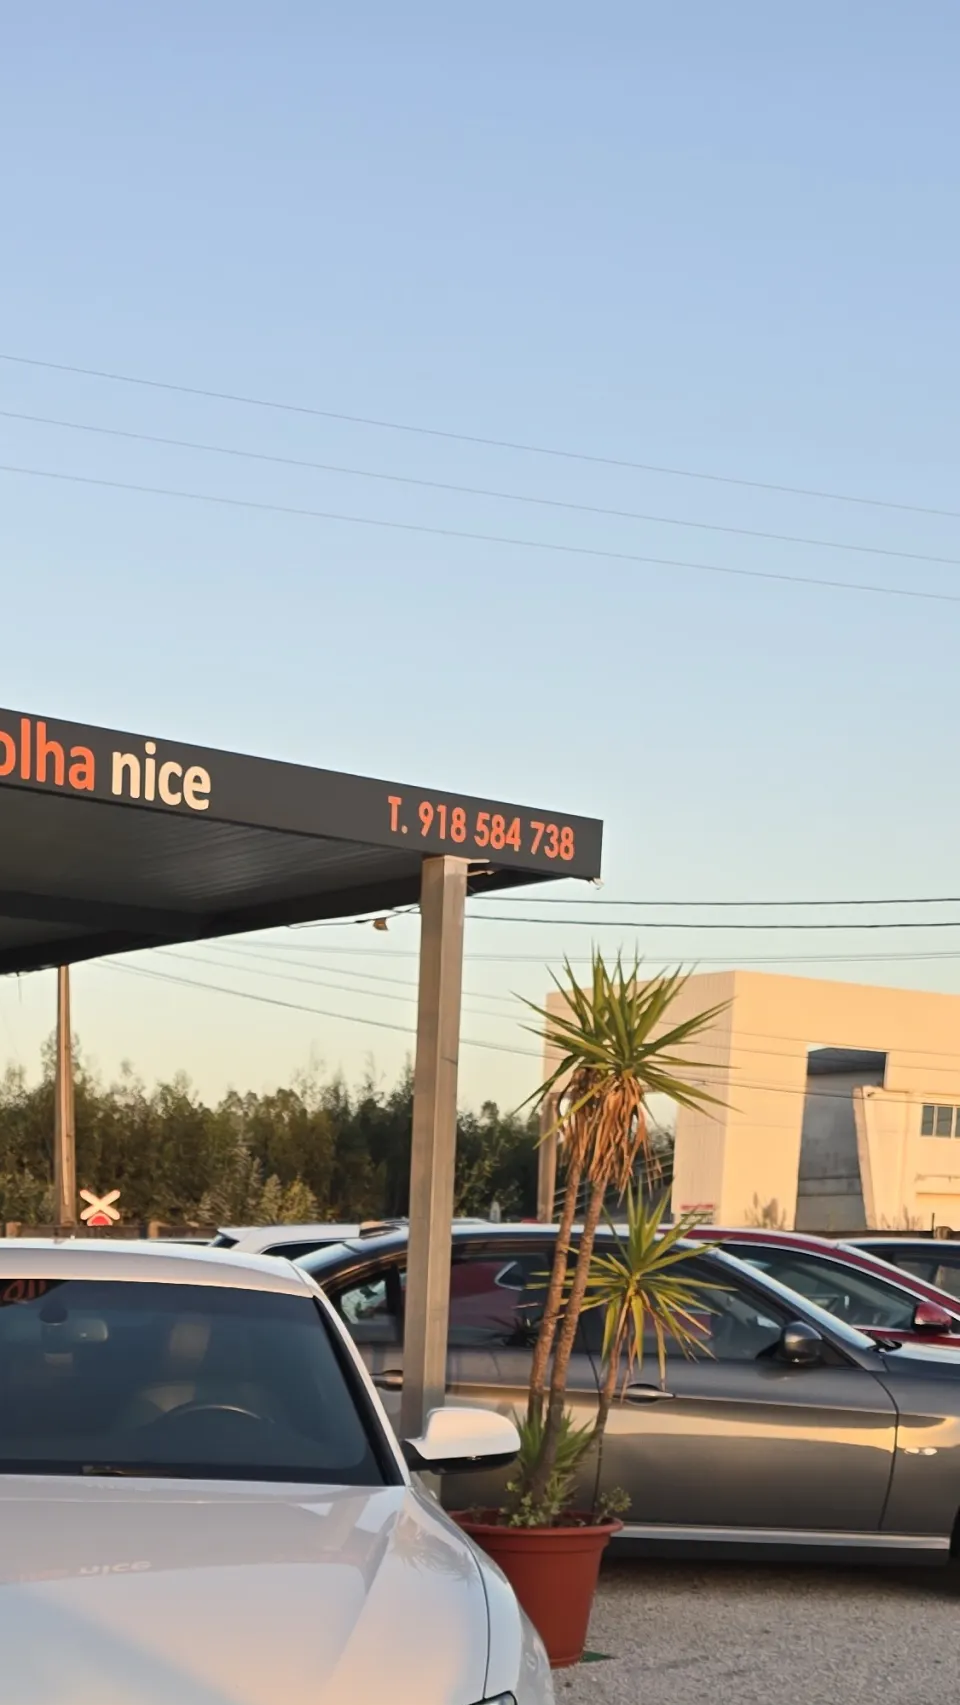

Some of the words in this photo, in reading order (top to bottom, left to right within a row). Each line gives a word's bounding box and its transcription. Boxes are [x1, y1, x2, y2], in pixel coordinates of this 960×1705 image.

[111, 741, 212, 811] nice
[387, 796, 408, 834] T.
[418, 801, 466, 843] 918
[474, 811, 521, 852] 584
[530, 821, 575, 861] 738
